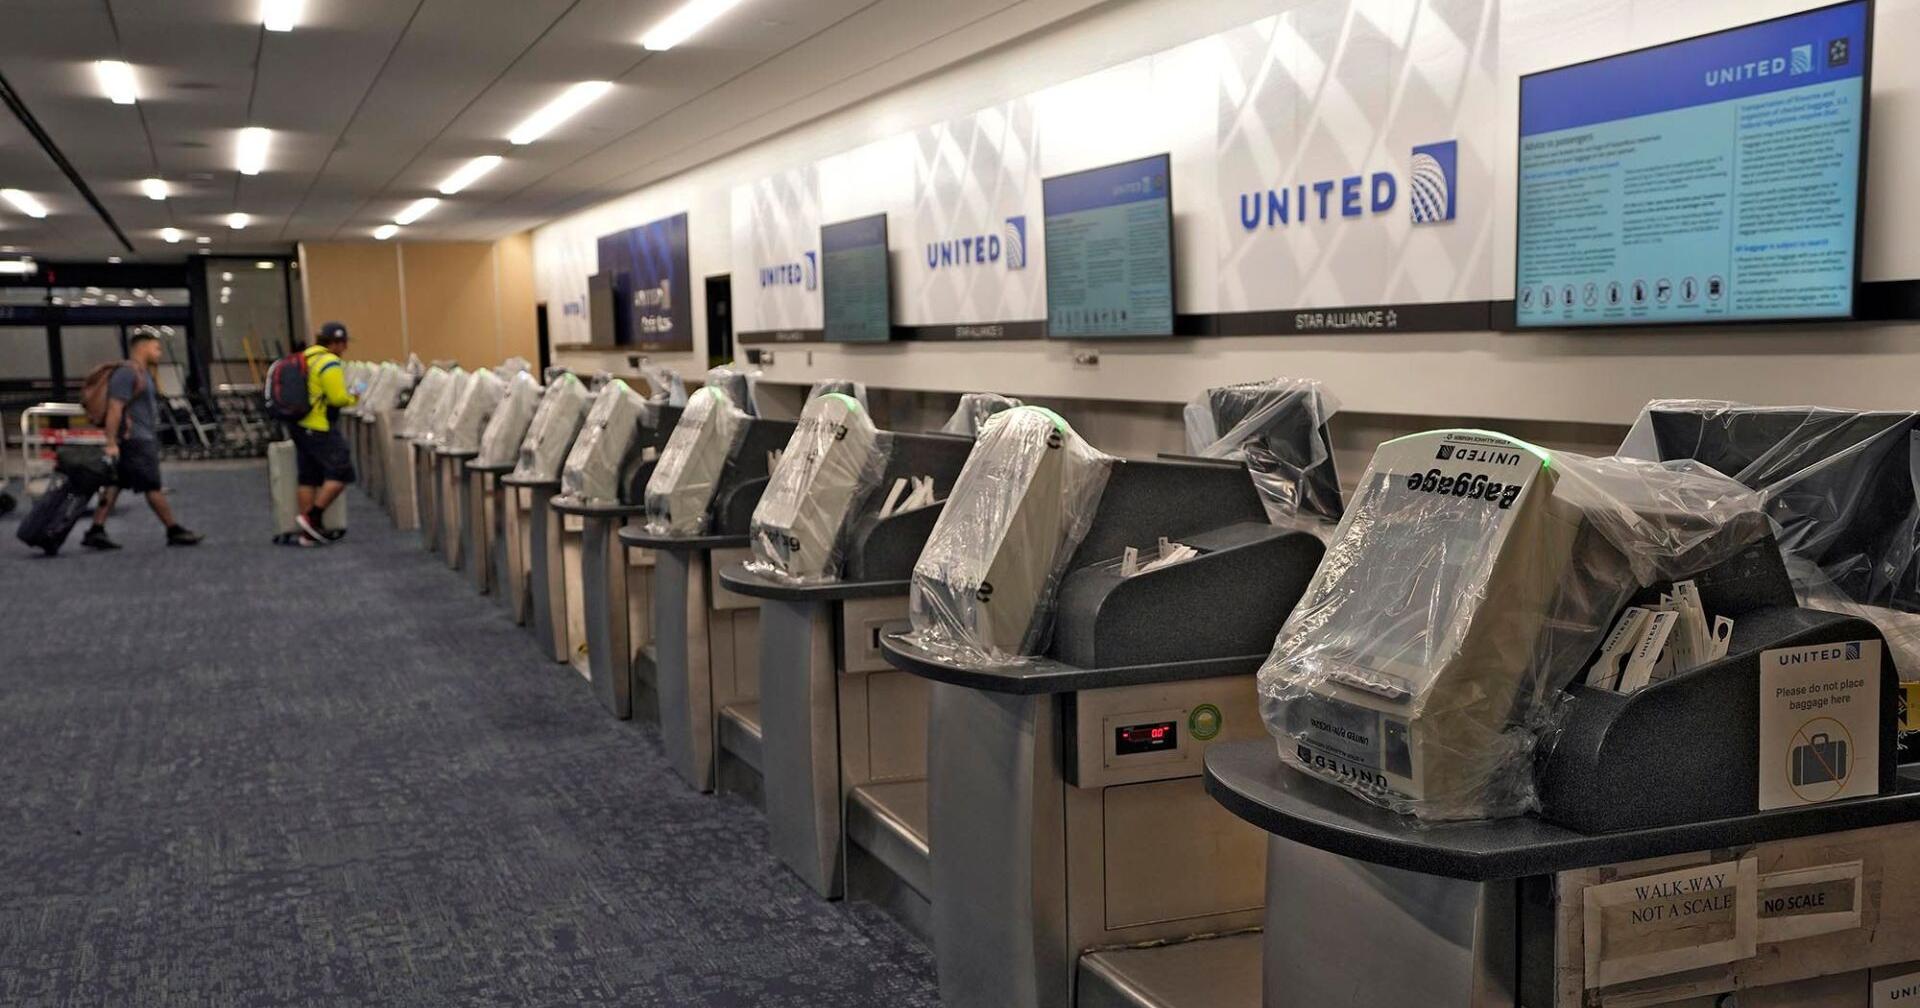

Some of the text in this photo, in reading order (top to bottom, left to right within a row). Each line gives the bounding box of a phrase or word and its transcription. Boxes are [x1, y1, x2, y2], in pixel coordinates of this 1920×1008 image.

[1705, 58, 1786, 86] UNITED
[1241, 171, 1397, 230] UNITED
[928, 235, 1000, 268] UNITED
[760, 263, 802, 288] UNITED
[1296, 311, 1383, 330] STAR ALLIANCE
[1455, 448, 1520, 466] UNITED
[1407, 468, 1522, 509] Baggage
[1607, 620, 1629, 652] UNITED
[1639, 624, 1658, 658] UNITED
[1780, 649, 1841, 665] UNITED
[1776, 679, 1865, 698] Please do not place
[1789, 694, 1851, 710] baggage here
[1315, 755, 1387, 788] UNITED
[1636, 874, 1725, 900] WALK-WAY
[1632, 894, 1732, 924] NOT A SCALE
[1764, 893, 1825, 913] NO SCALE
[1890, 985, 1920, 1000] UNI
